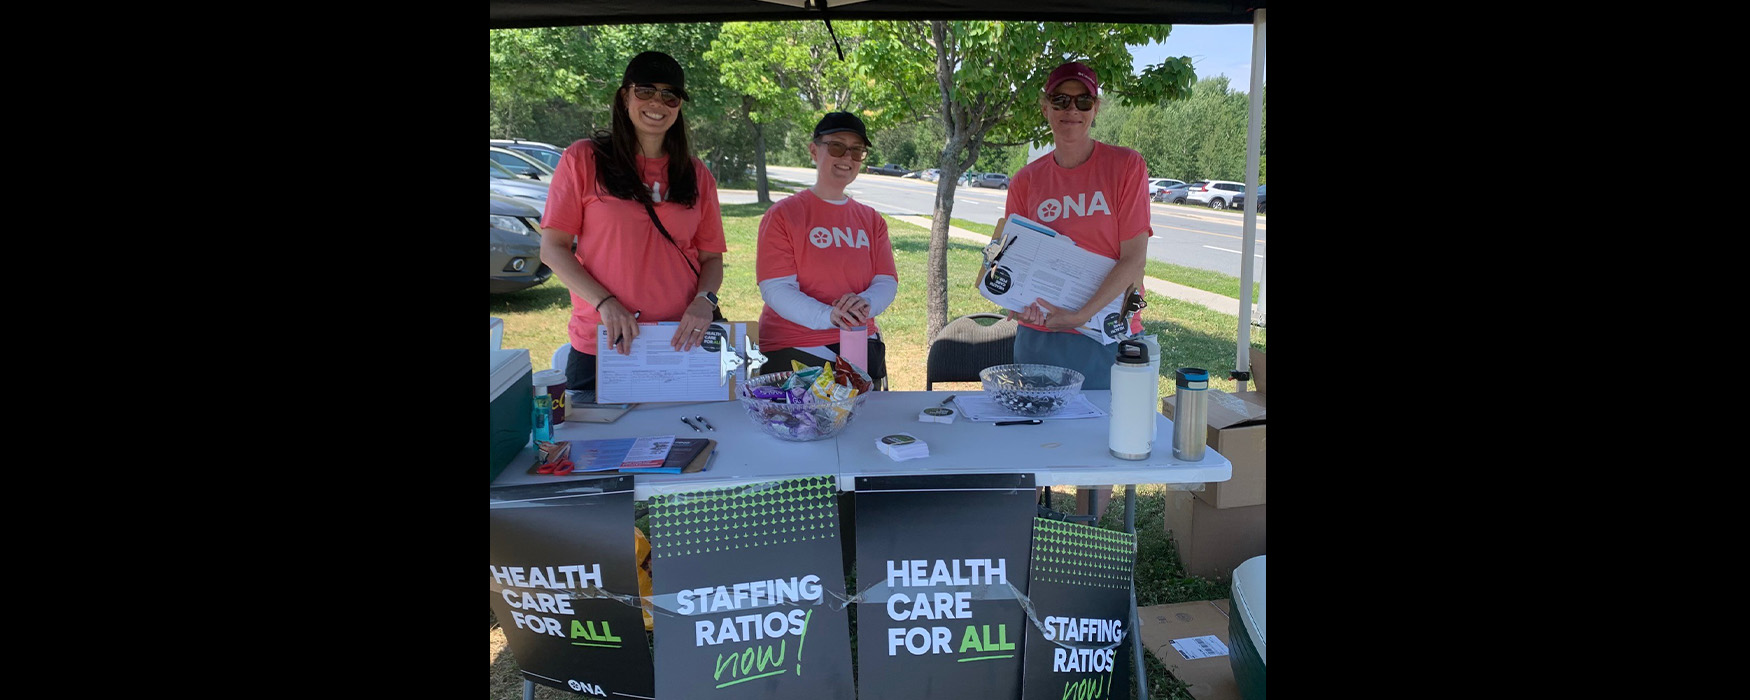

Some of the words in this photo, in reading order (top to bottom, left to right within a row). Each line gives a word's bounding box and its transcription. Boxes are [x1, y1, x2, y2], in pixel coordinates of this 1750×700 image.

[1037, 191, 1111, 222] ONA
[809, 227, 870, 250] ONA
[490, 564, 603, 589] HEALTH
[887, 558, 1007, 587] HEALTH
[502, 589, 575, 615] CARE
[677, 574, 822, 615] STAFFING
[887, 592, 973, 621] CARE
[511, 611, 565, 638] FOR
[570, 619, 622, 643] ALL
[695, 609, 806, 647] RATIOS
[888, 627, 953, 656] FOR
[959, 624, 1015, 653] ALL
[1043, 616, 1122, 643] STAFFING
[1053, 647, 1114, 673] RATIOS
[567, 679, 607, 697] ONA
